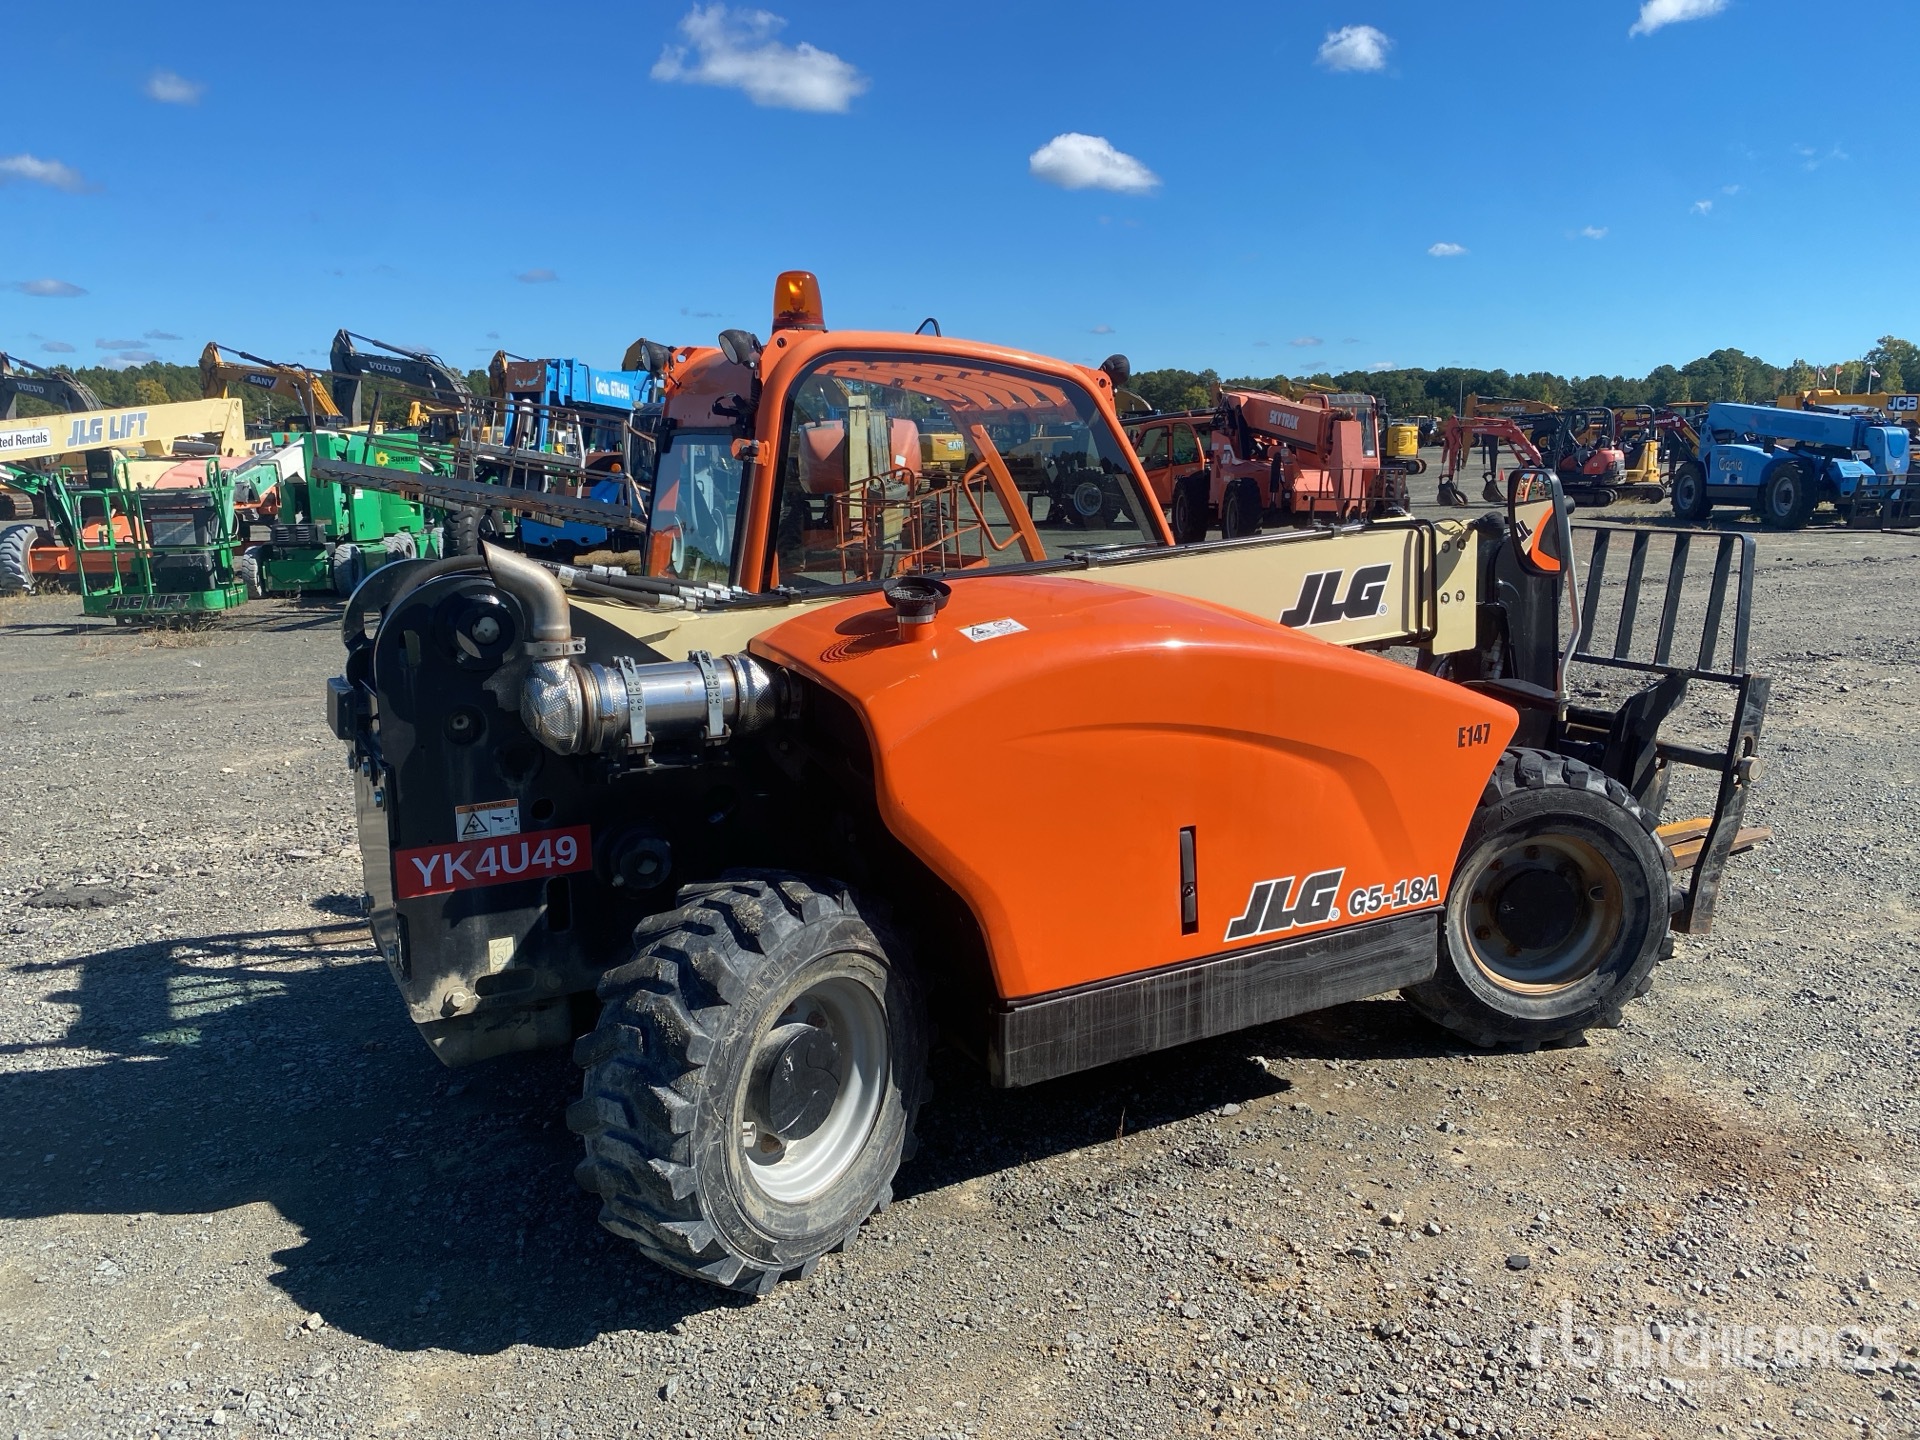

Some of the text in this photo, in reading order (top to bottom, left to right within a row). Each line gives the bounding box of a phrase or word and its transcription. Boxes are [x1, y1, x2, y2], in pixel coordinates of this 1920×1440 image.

[368, 361, 402, 374] VOLVO
[16, 382, 45, 394] VOLVO
[250, 375, 273, 387] SANY
[1887, 396, 1918, 410] JCB
[1269, 410, 1300, 430] SKYTRAK
[66, 411, 149, 448] JLG LIFT
[15, 432, 47, 446] Rentals
[1718, 457, 1743, 471] Genie
[106, 594, 191, 610] JLG LIFT
[1278, 562, 1393, 629] JLG
[1457, 723, 1491, 748] E147
[476, 802, 507, 811] WARNING
[411, 835, 578, 888] YK4U49
[1223, 867, 1440, 943] JLG G5-18A
